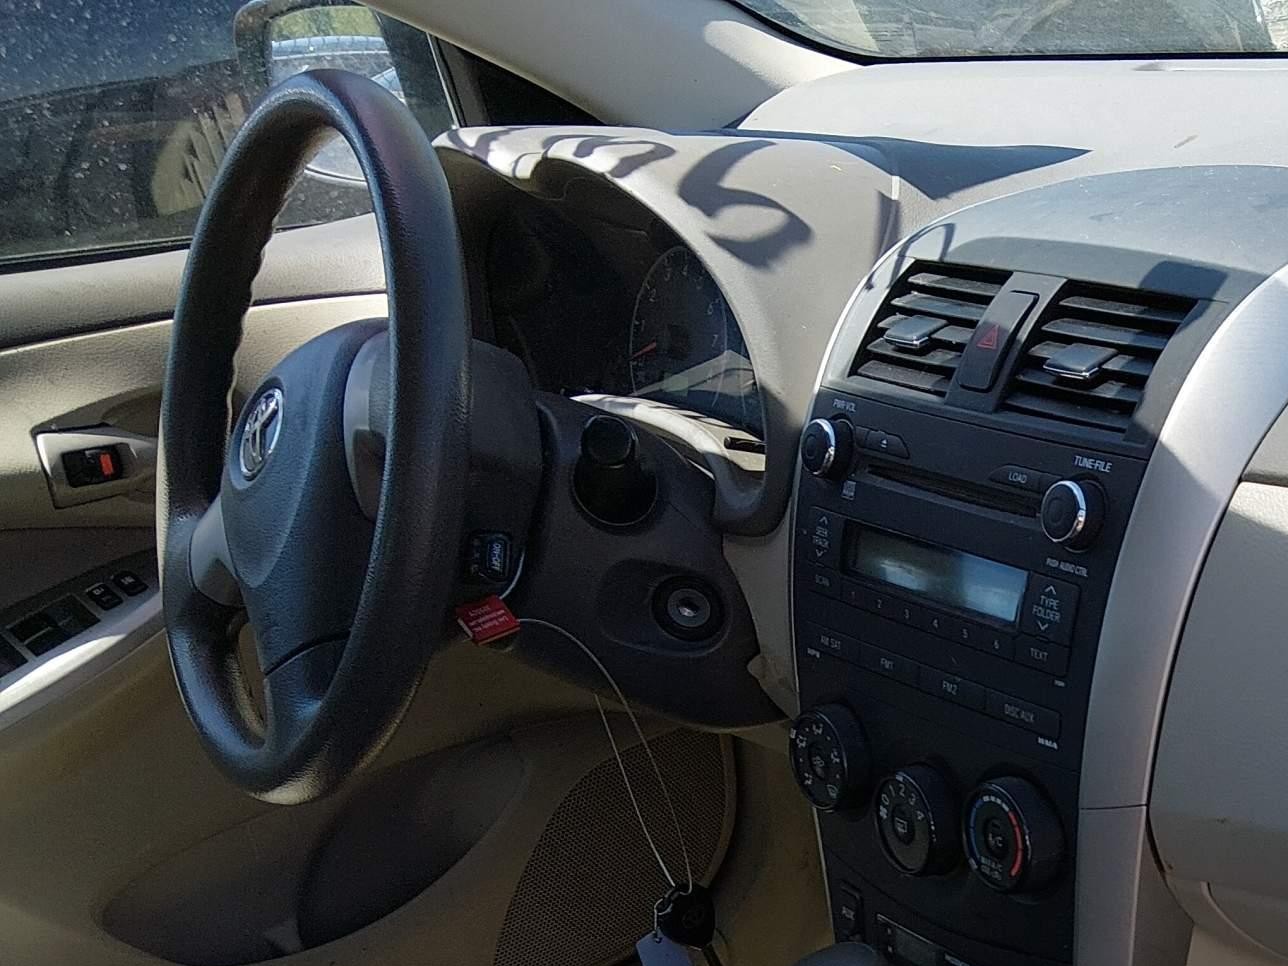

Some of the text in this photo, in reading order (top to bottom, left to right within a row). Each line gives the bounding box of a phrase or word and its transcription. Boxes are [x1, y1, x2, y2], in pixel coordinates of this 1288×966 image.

[1040, 595, 1060, 610] TYPE
[1031, 604, 1061, 623] FOLDER
[1030, 647, 1049, 662] TEXT
